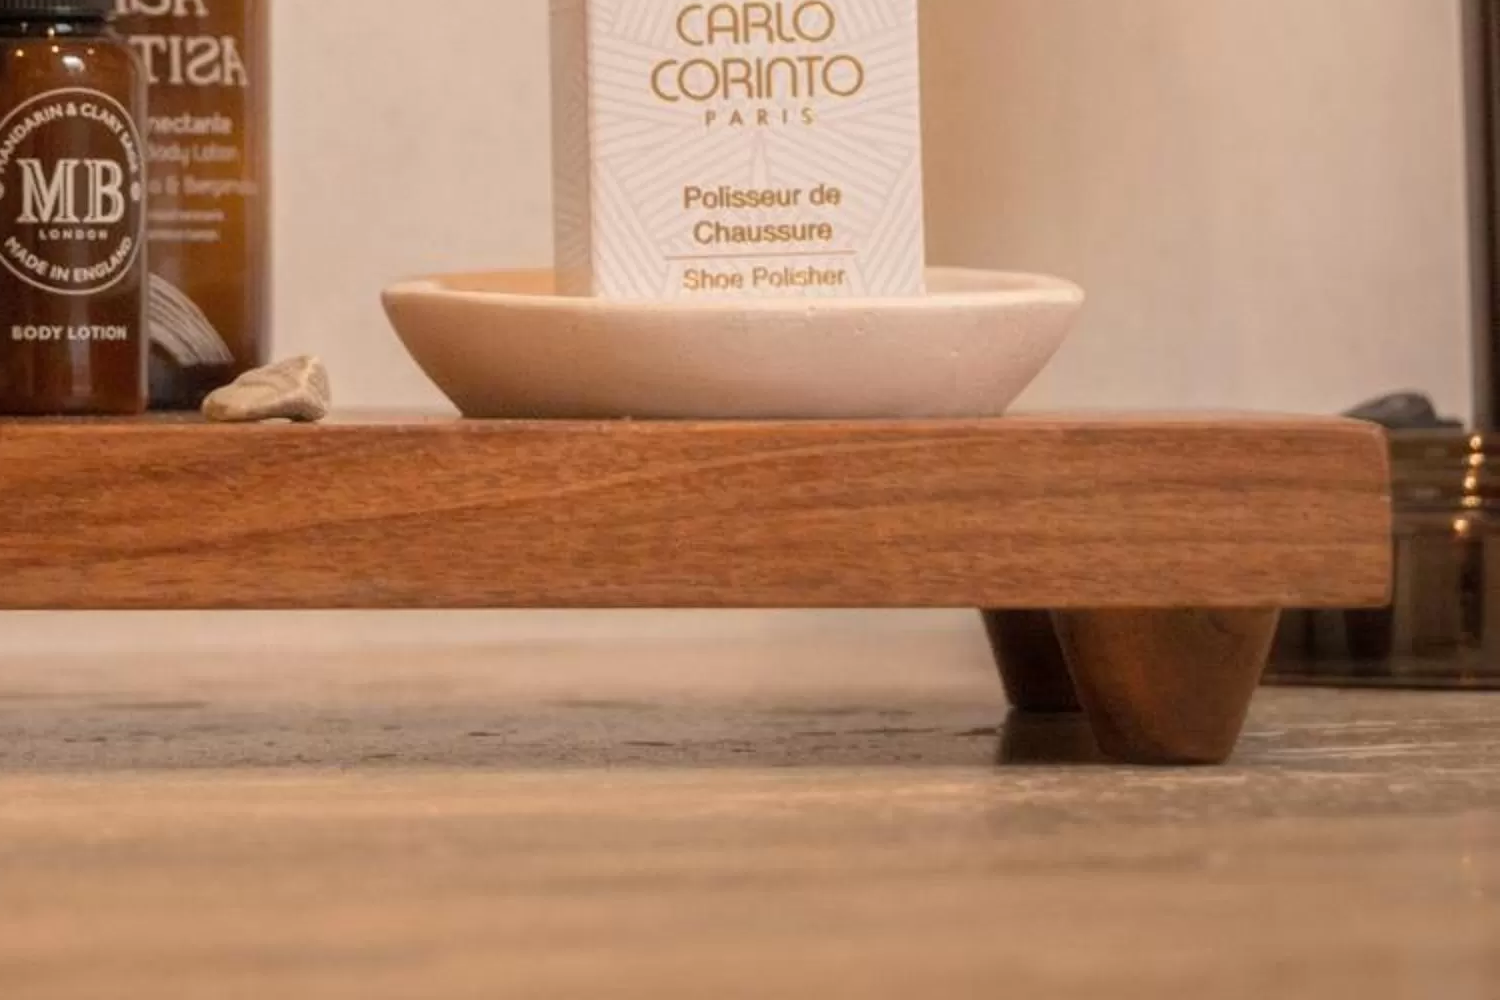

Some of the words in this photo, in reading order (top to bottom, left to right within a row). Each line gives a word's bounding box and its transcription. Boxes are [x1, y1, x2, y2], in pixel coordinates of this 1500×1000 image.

[676, 0, 836, 46] CARLO
[650, 54, 865, 102] CORINTO
[80, 103, 124, 134] CLARY
[705, 107, 816, 127] PARIS
[15, 159, 125, 223] MB
[683, 184, 802, 209] Polisseur
[808, 183, 841, 207] de
[38, 229, 108, 240] LONDON
[692, 220, 833, 245] Chaussure
[4, 236, 49, 276] MADE
[50, 265, 69, 281] IN
[73, 236, 132, 282] ENGLAND
[683, 267, 744, 290] Shoe
[752, 265, 846, 288] Polisher
[11, 325, 64, 340] BODY
[67, 325, 127, 341] LOTION
